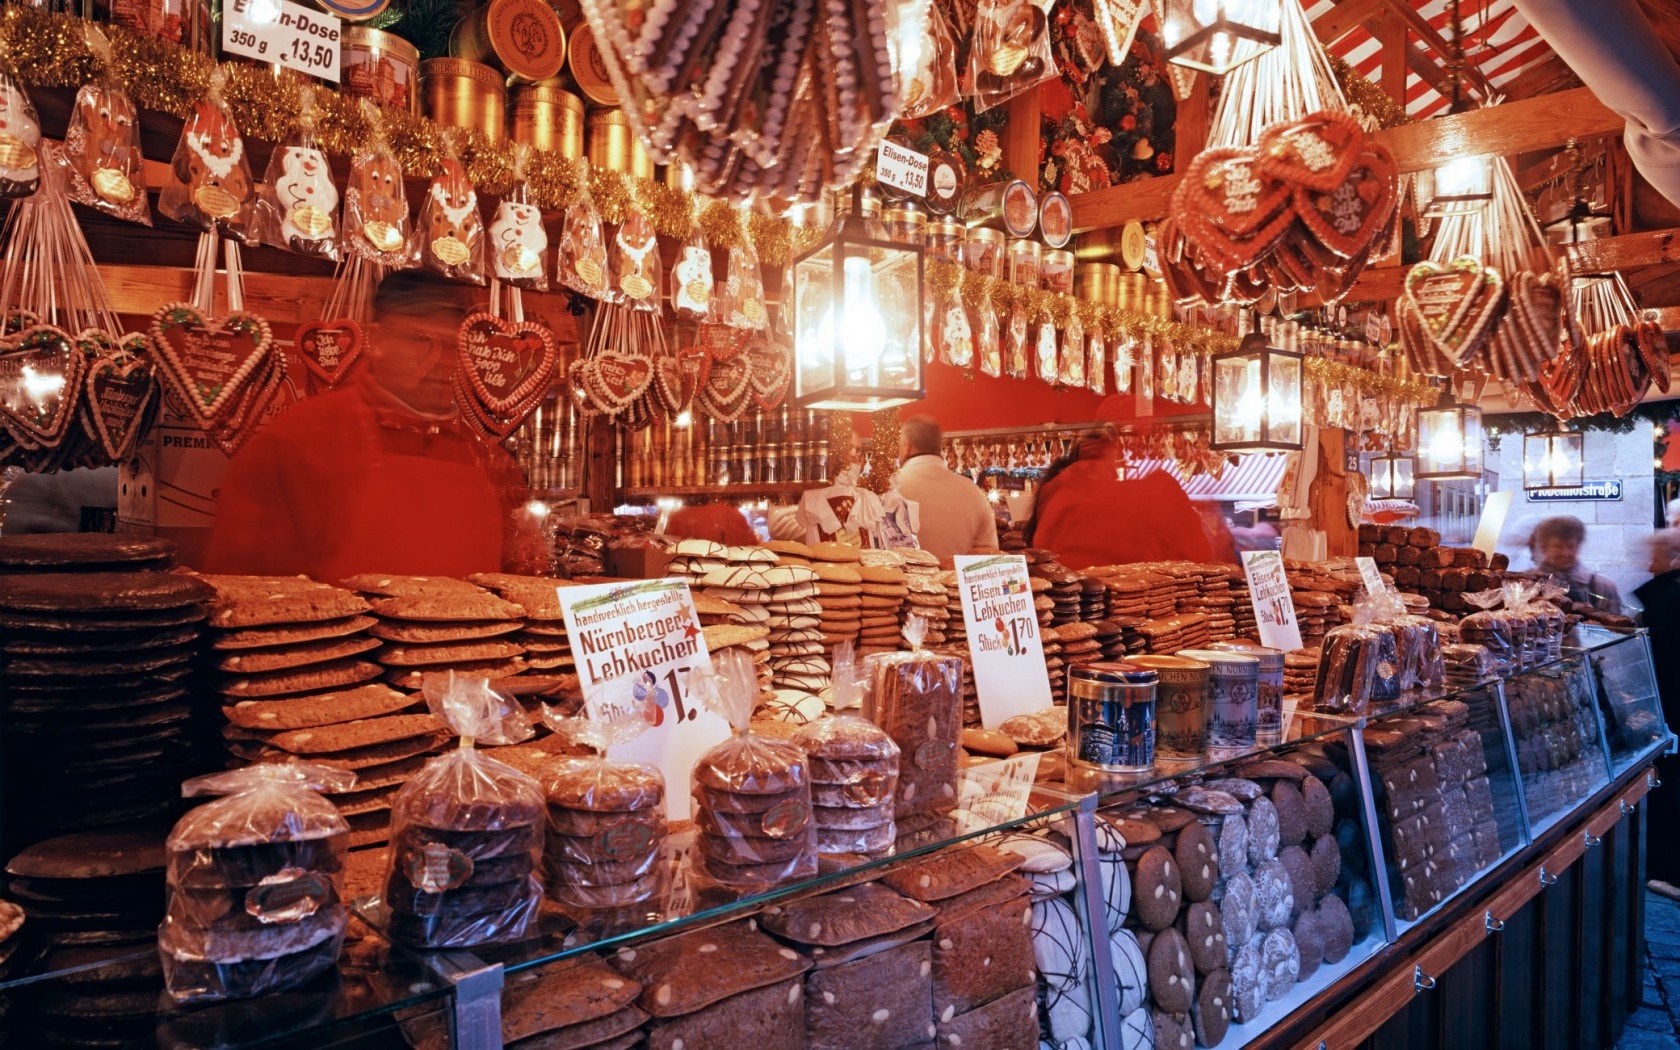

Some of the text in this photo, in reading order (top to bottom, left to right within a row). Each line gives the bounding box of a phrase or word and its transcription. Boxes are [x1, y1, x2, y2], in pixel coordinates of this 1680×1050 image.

[233, 0, 340, 42] En-Dose
[230, 30, 256, 48] 350
[258, 41, 268, 54] g
[882, 145, 928, 172] Elisen-Dose
[880, 167, 892, 179] 350
[970, 583, 1001, 603] Elisen
[573, 589, 685, 628] handwerklich hergestellte
[973, 595, 1027, 623] Lebkuchen
[579, 614, 683, 656] Nürnberger
[586, 638, 699, 685] Lebkuchen
